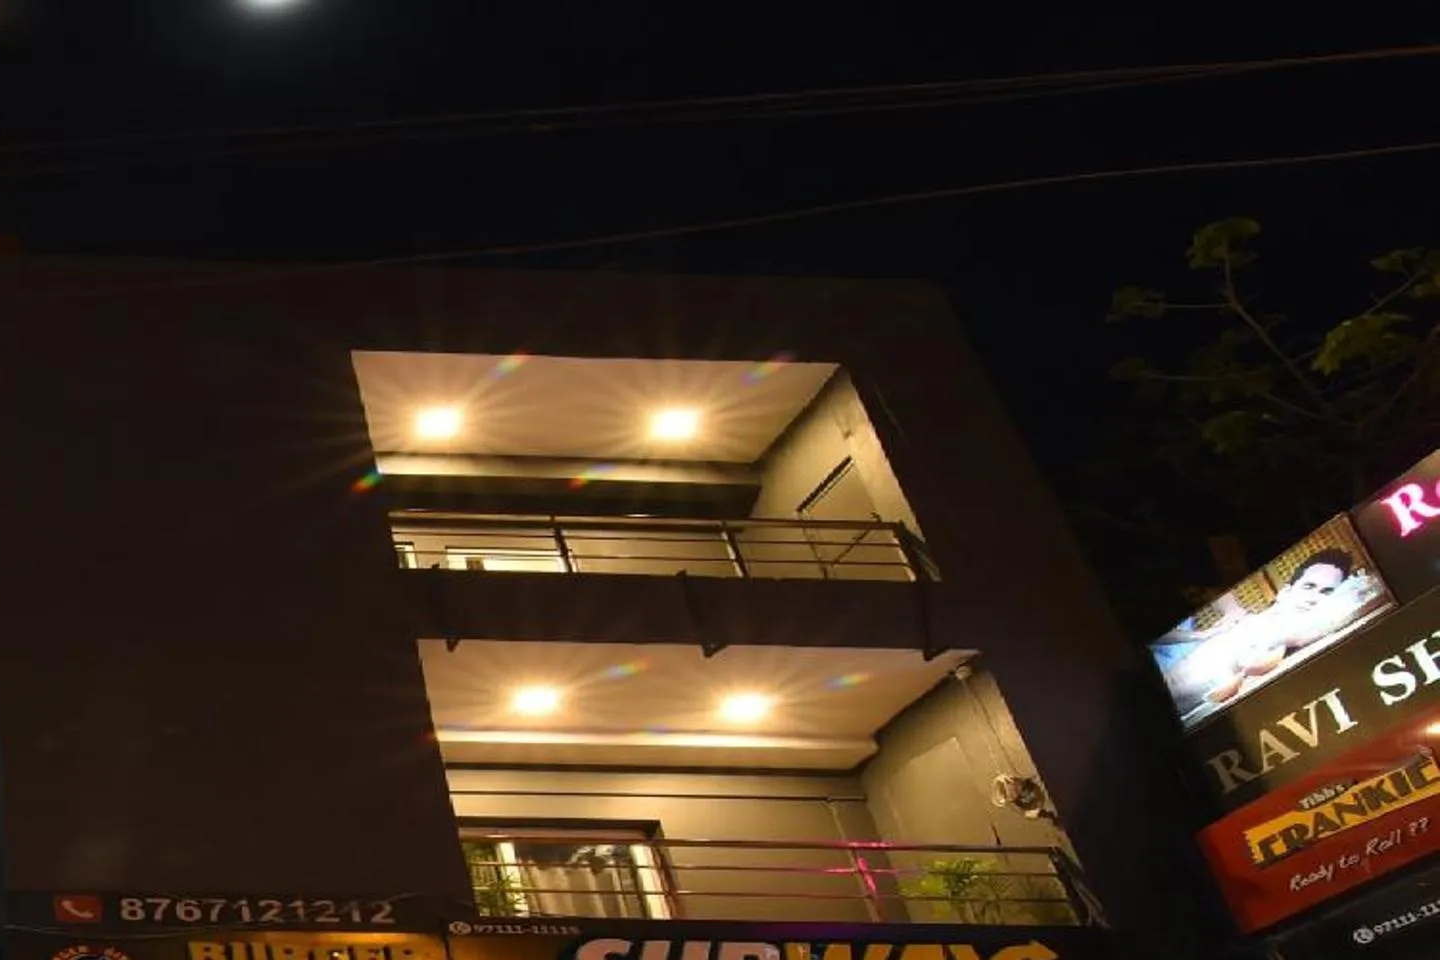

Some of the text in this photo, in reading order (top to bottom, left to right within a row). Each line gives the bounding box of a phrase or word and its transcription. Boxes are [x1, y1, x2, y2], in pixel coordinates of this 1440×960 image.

[1380, 480, 1440, 539] R
[1207, 687, 1359, 795] RAVI
[1289, 862, 1334, 892] Ready
[1338, 852, 1361, 869] to
[1365, 828, 1402, 858] Roll
